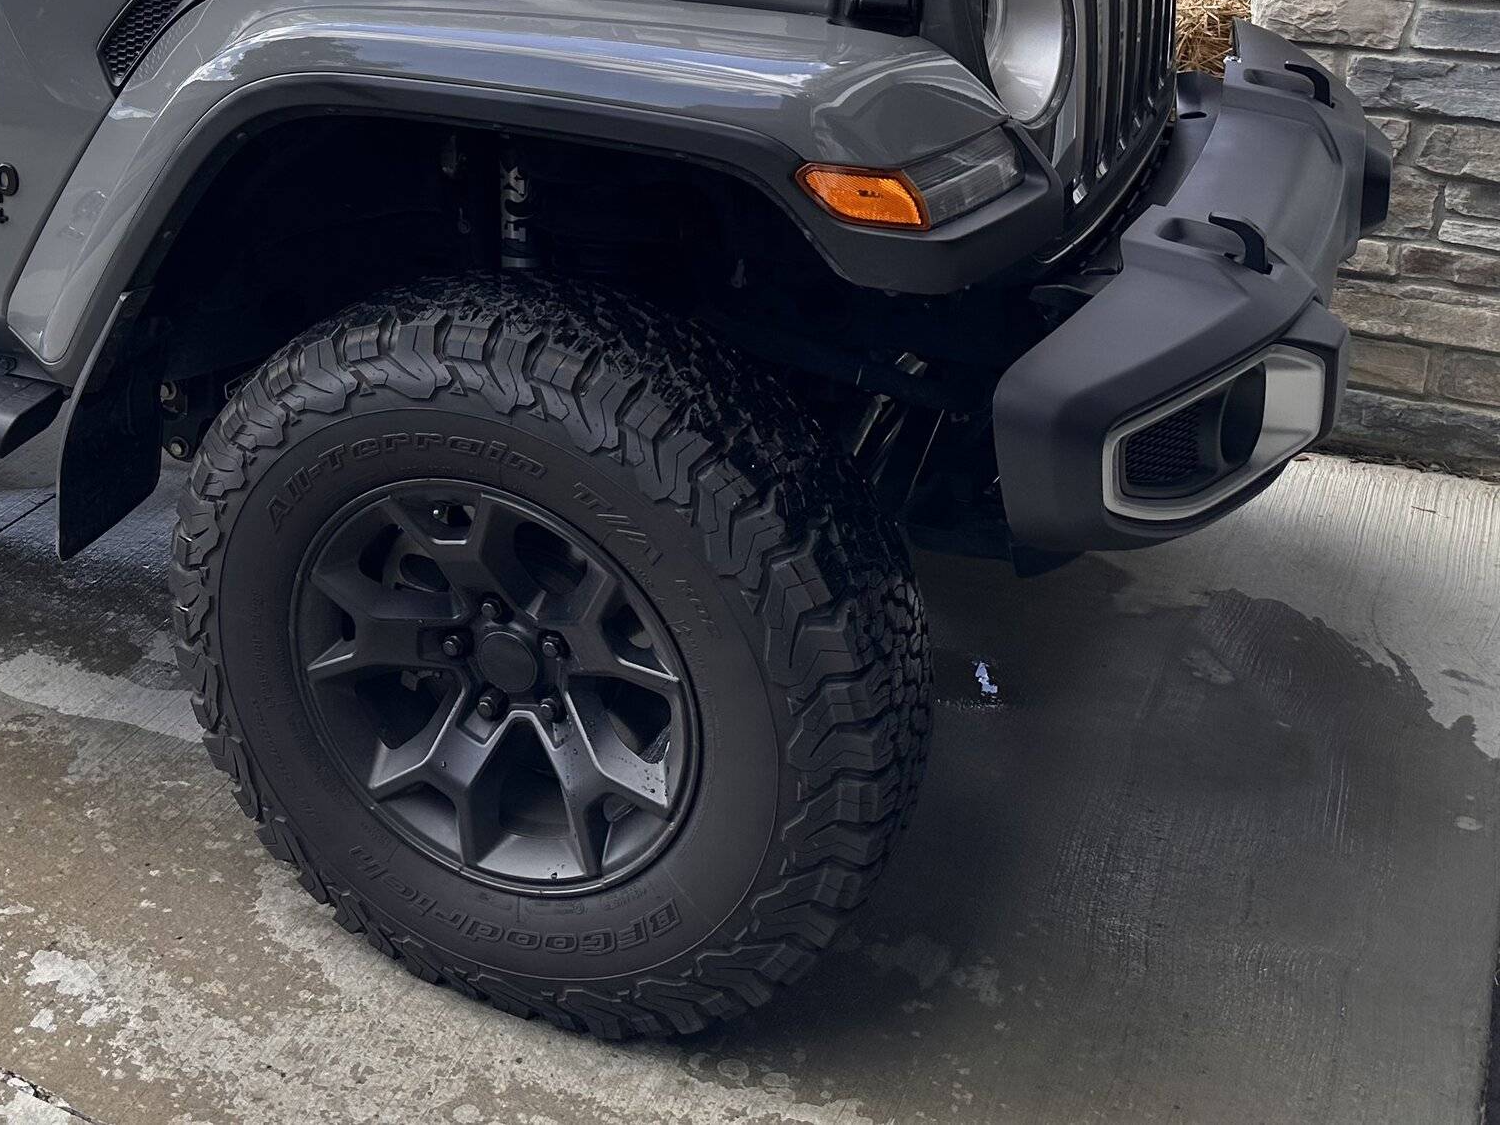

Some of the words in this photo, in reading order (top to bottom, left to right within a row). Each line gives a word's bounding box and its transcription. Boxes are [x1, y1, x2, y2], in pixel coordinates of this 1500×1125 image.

[501, 162, 532, 243] FOX
[266, 432, 548, 533] All-Terrain
[350, 845, 682, 955] BFGoodrich
